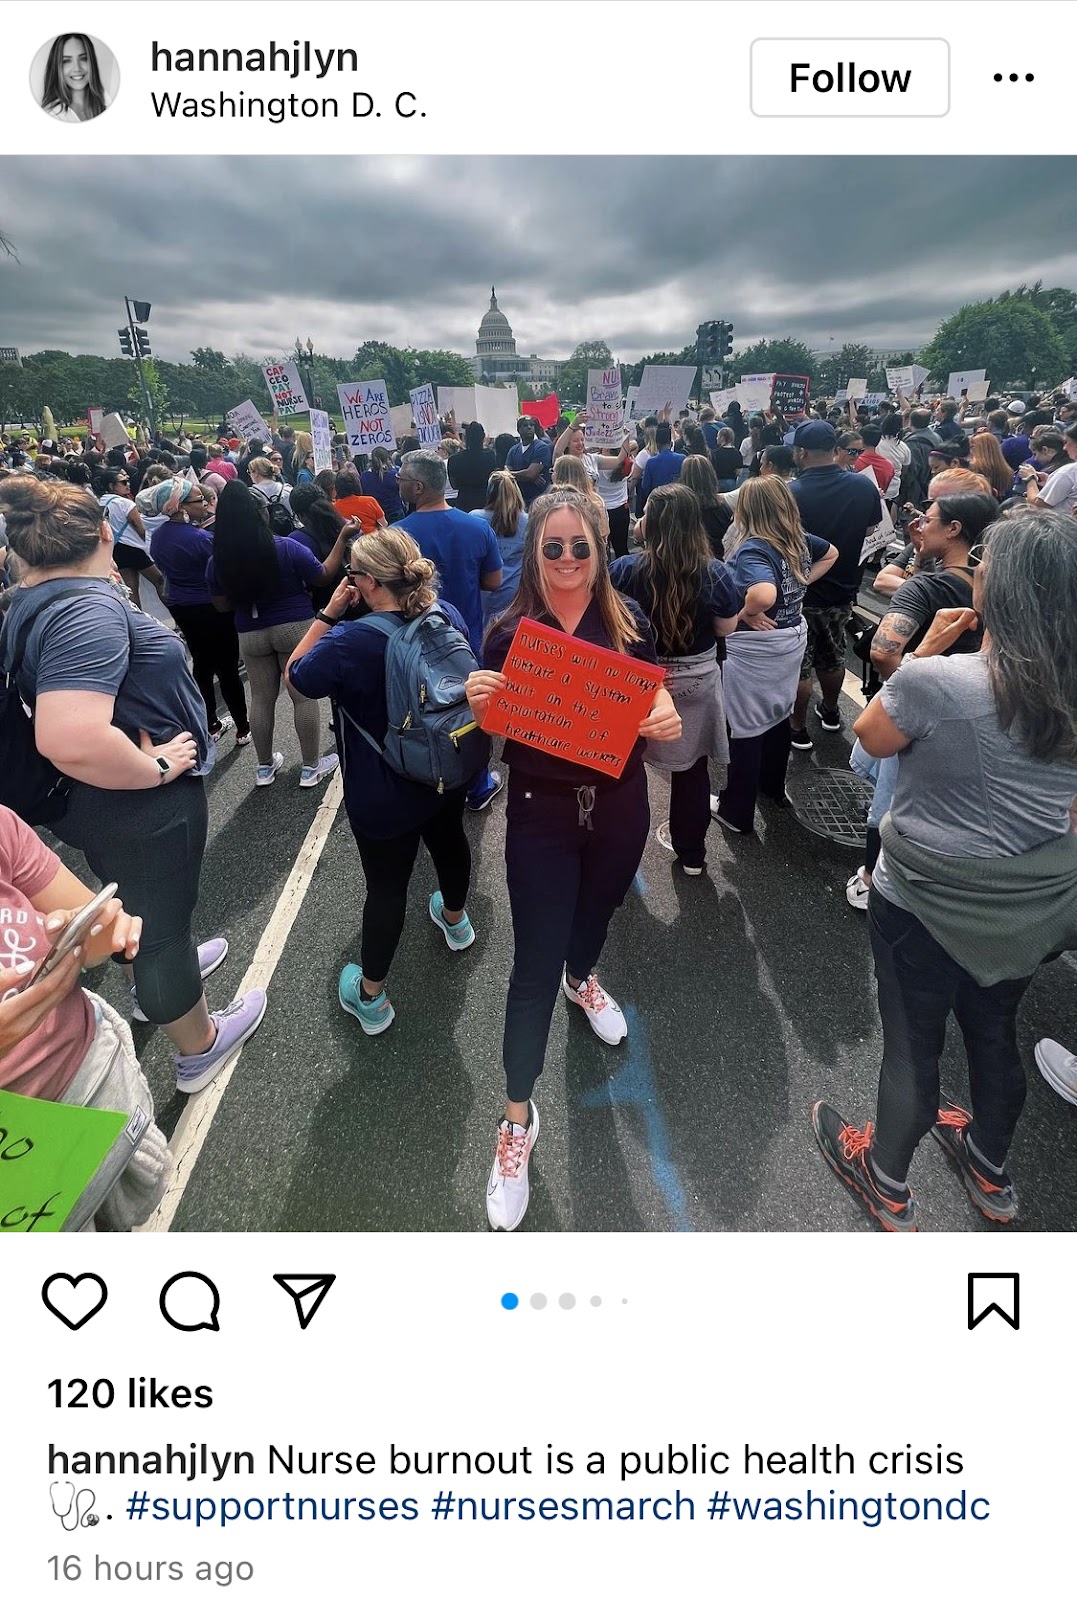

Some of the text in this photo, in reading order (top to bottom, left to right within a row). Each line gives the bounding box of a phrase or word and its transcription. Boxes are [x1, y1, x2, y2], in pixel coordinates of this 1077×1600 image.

[266, 366, 284, 377] CAP
[269, 374, 289, 385] CEO
[271, 382, 290, 393] PAY
[275, 390, 293, 400] NOT
[276, 395, 304, 407] NURSE
[278, 404, 297, 415] PAY
[342, 401, 388, 421] HEROS
[359, 418, 385, 433] NOT
[350, 429, 393, 446] ZEROS
[519, 633, 566, 659] nurses
[571, 652, 598, 671] will
[605, 666, 620, 678] no
[510, 655, 632, 705] tolerate a system
[505, 677, 602, 722] built on the
[496, 698, 610, 742] exploitation of
[505, 721, 622, 768] healthcare workers
